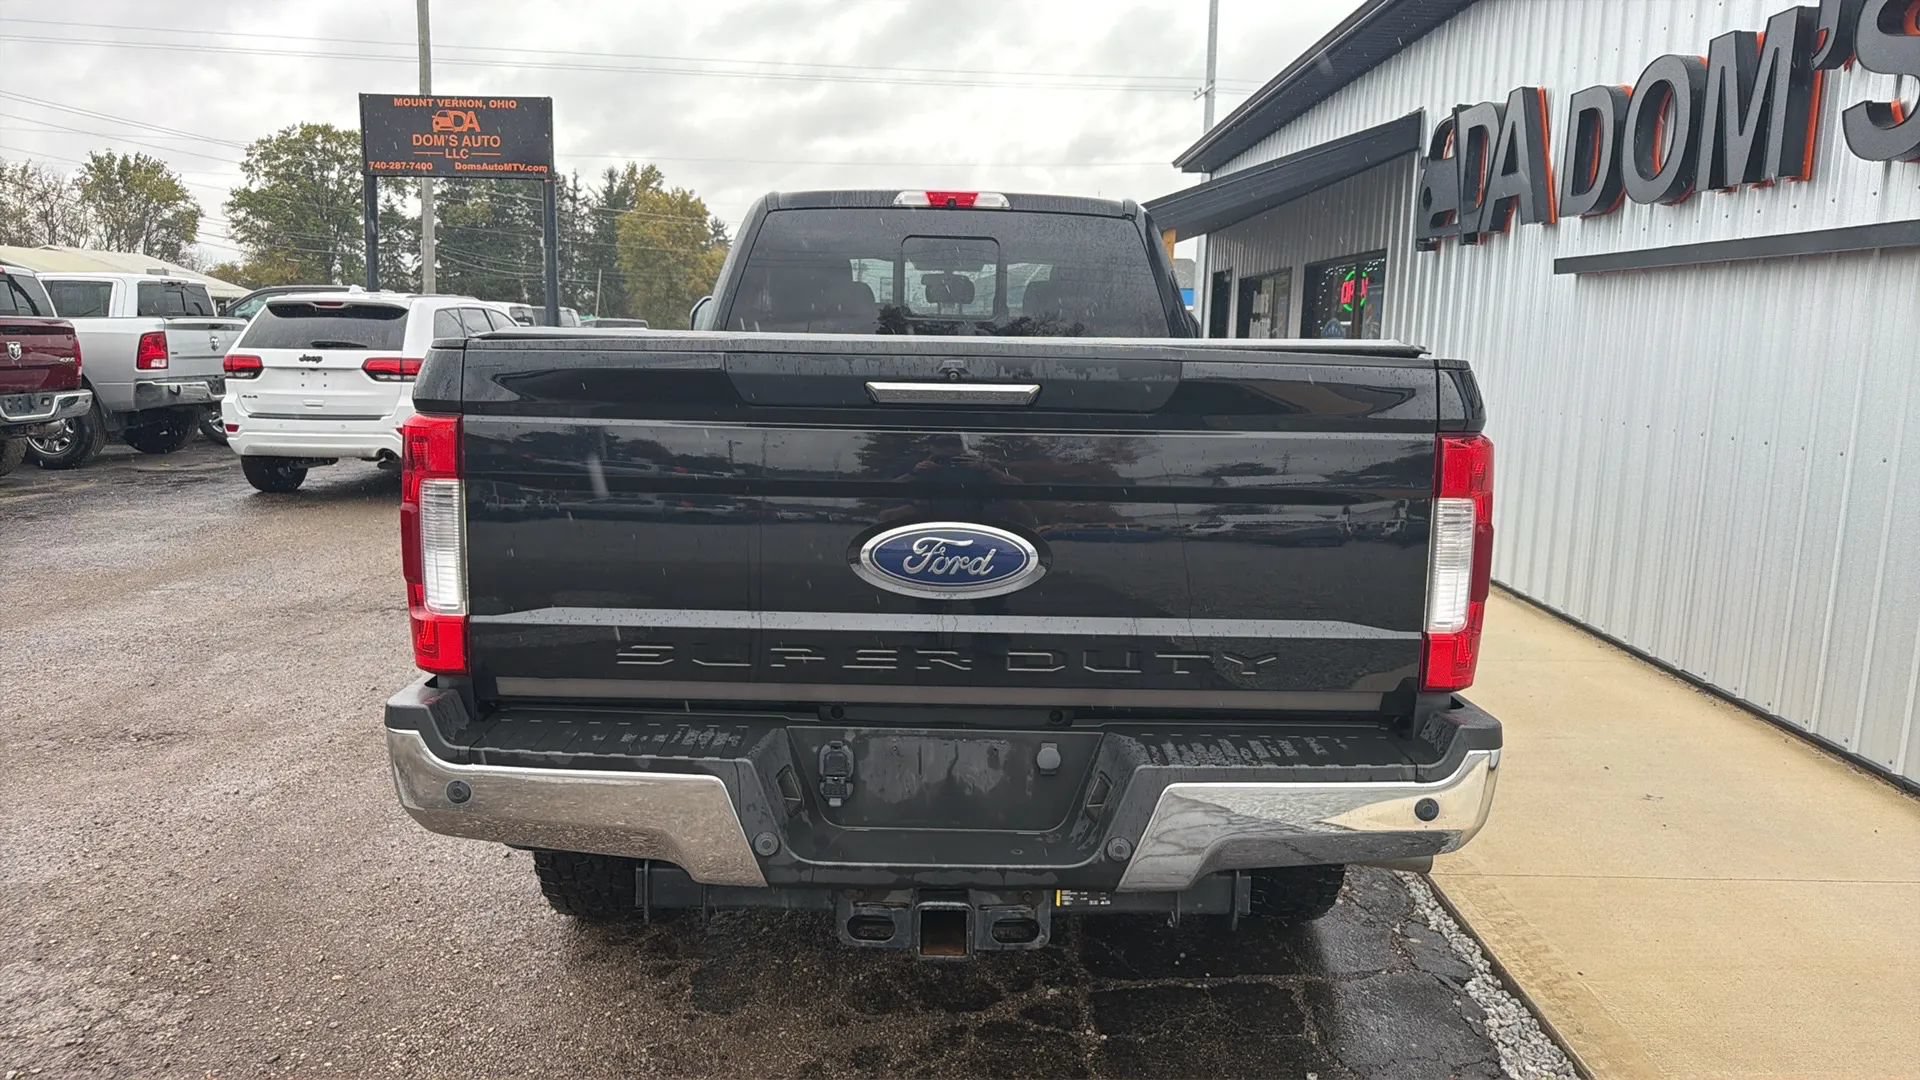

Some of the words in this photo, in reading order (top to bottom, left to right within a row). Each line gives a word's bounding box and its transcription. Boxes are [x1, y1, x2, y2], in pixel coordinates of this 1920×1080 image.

[393, 97, 434, 107] MOUNT
[436, 98, 486, 110] VERNON,
[489, 99, 517, 109] OHIO
[412, 134, 459, 147] DOM'S
[462, 135, 501, 148] AUTO
[445, 148, 469, 159] LLC
[368, 161, 433, 171] 740-287-7400
[454, 162, 548, 173] DomsAutoMTV.com
[299, 353, 323, 363] Jeep
[903, 536, 997, 576] Ford
[615, 643, 974, 672] SUPER
[1006, 649, 1279, 676] DUTY
